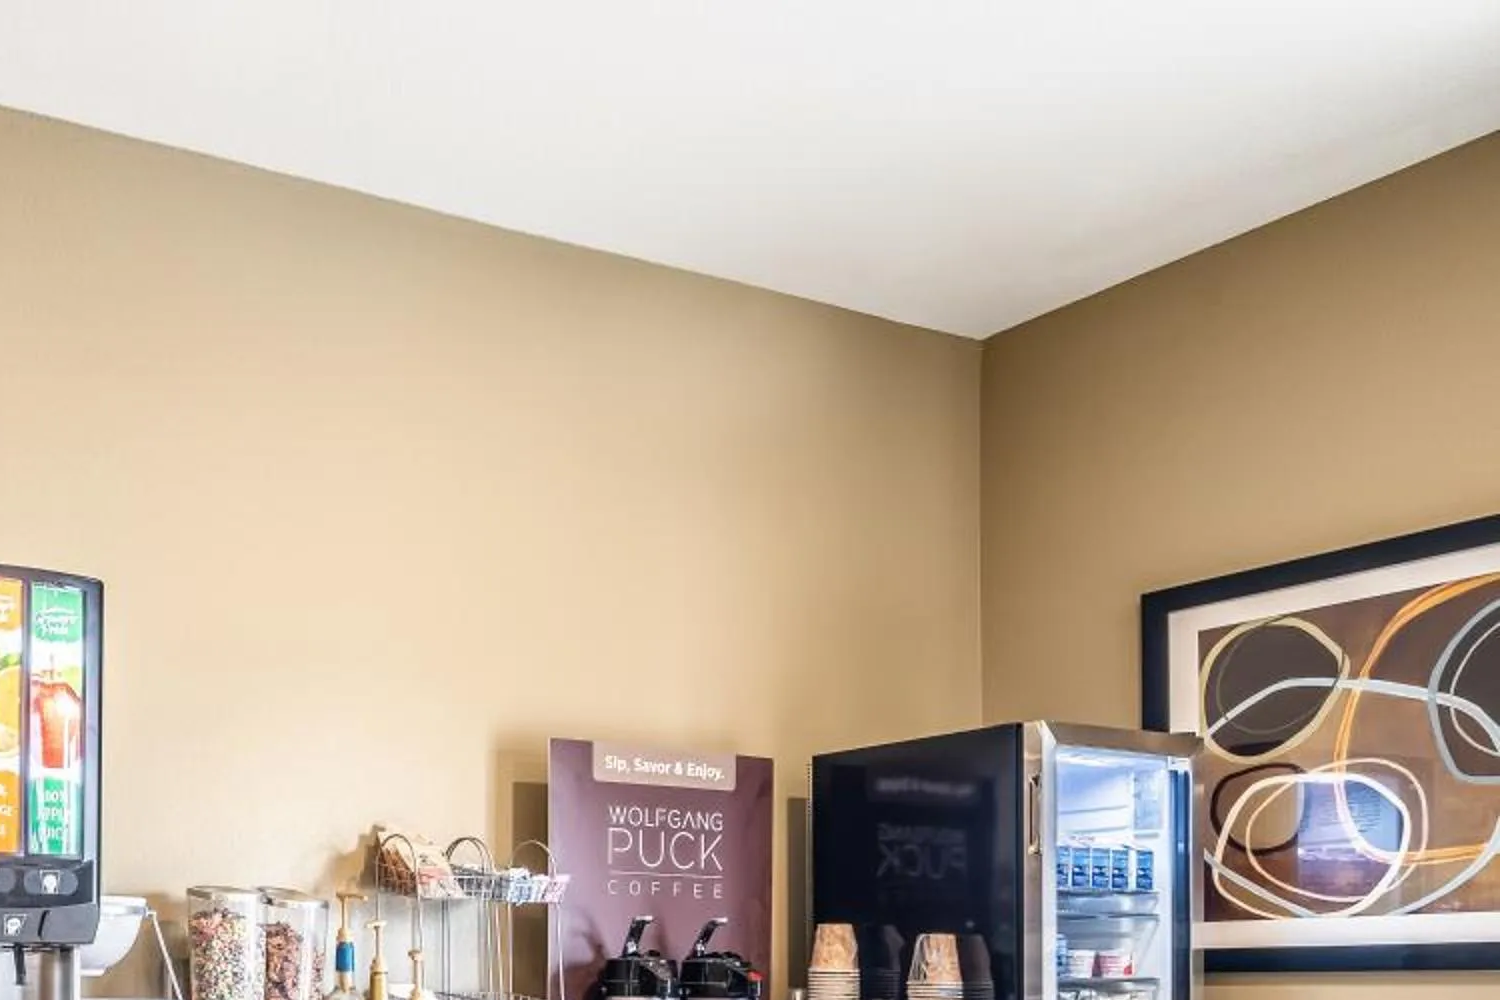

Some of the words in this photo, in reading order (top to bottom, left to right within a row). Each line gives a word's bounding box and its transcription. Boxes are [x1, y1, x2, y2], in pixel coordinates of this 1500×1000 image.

[605, 755, 630, 774] Sip,
[634, 758, 671, 772] Savor
[675, 762, 683, 775] &
[687, 763, 725, 781] Enjoy.
[608, 805, 724, 832] WOLFGANG
[607, 827, 723, 871] PUCK
[607, 879, 723, 899] COFFEE
